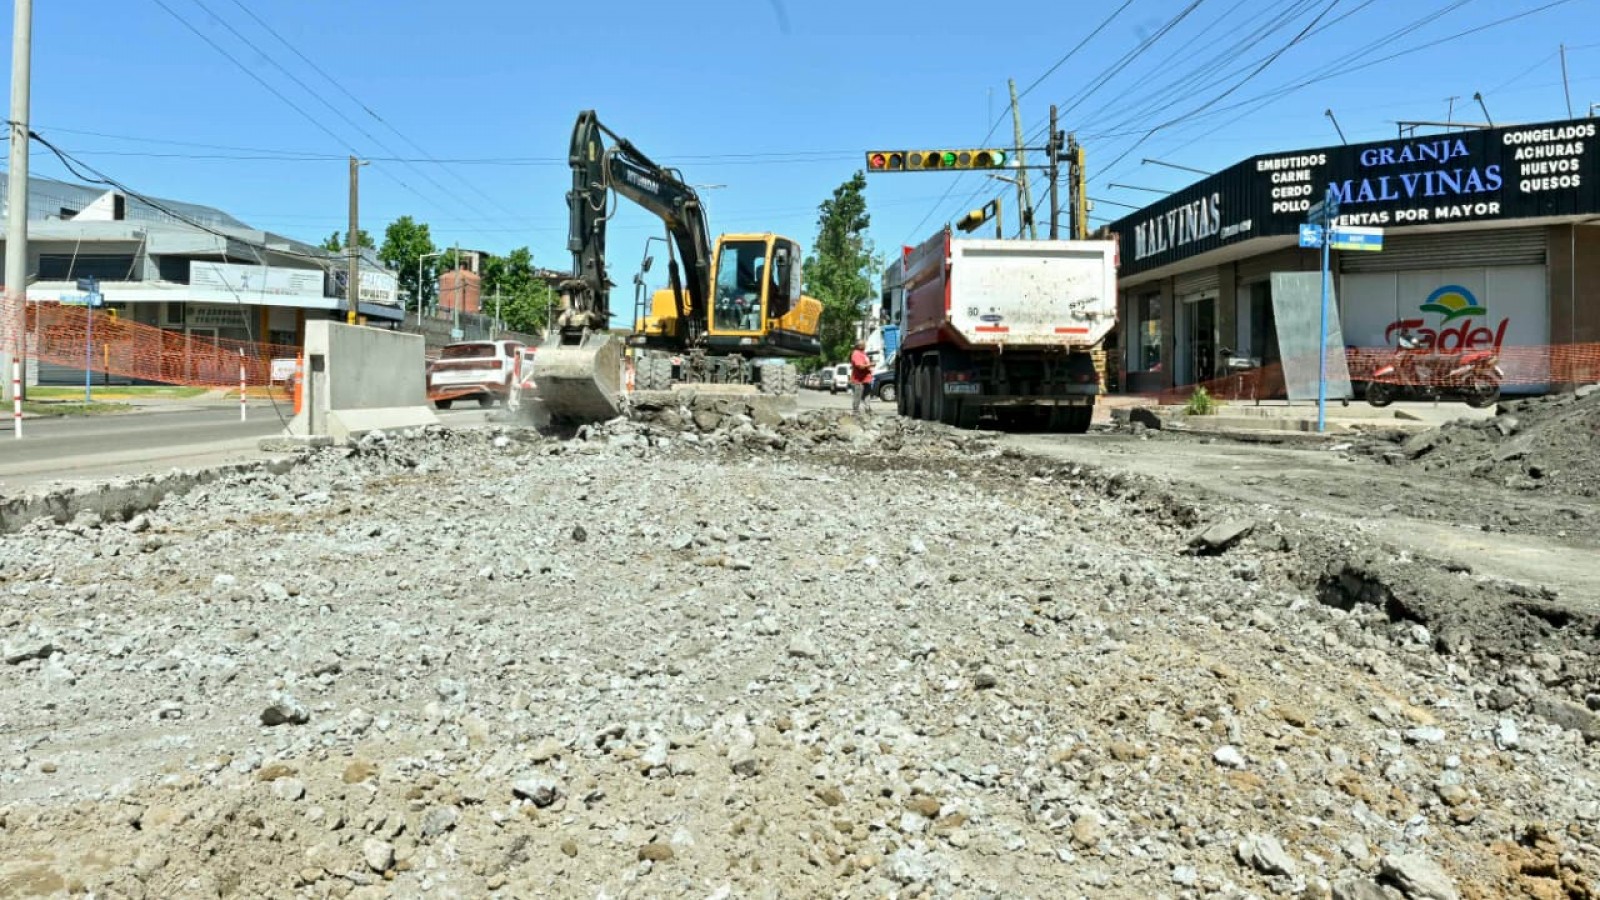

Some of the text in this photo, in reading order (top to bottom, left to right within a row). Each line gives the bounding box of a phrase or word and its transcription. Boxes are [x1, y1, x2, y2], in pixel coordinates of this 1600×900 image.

[1503, 124, 1596, 146] CONGELADOS
[1360, 139, 1470, 167] GRANJA
[1515, 141, 1584, 161] ACHURAS
[1257, 154, 1326, 171] EMBUTIDOS
[1520, 158, 1580, 176] HUEVOS
[1271, 169, 1311, 183] CARNE
[1329, 165, 1503, 205] MALVINAS
[1519, 173, 1581, 193] QUESOS
[1271, 184, 1312, 199] CERDO
[1272, 200, 1310, 214] POLLO
[1395, 208, 1429, 223] POR
[1434, 201, 1500, 218] MAYOR
[1135, 192, 1221, 260] MALVINAS
